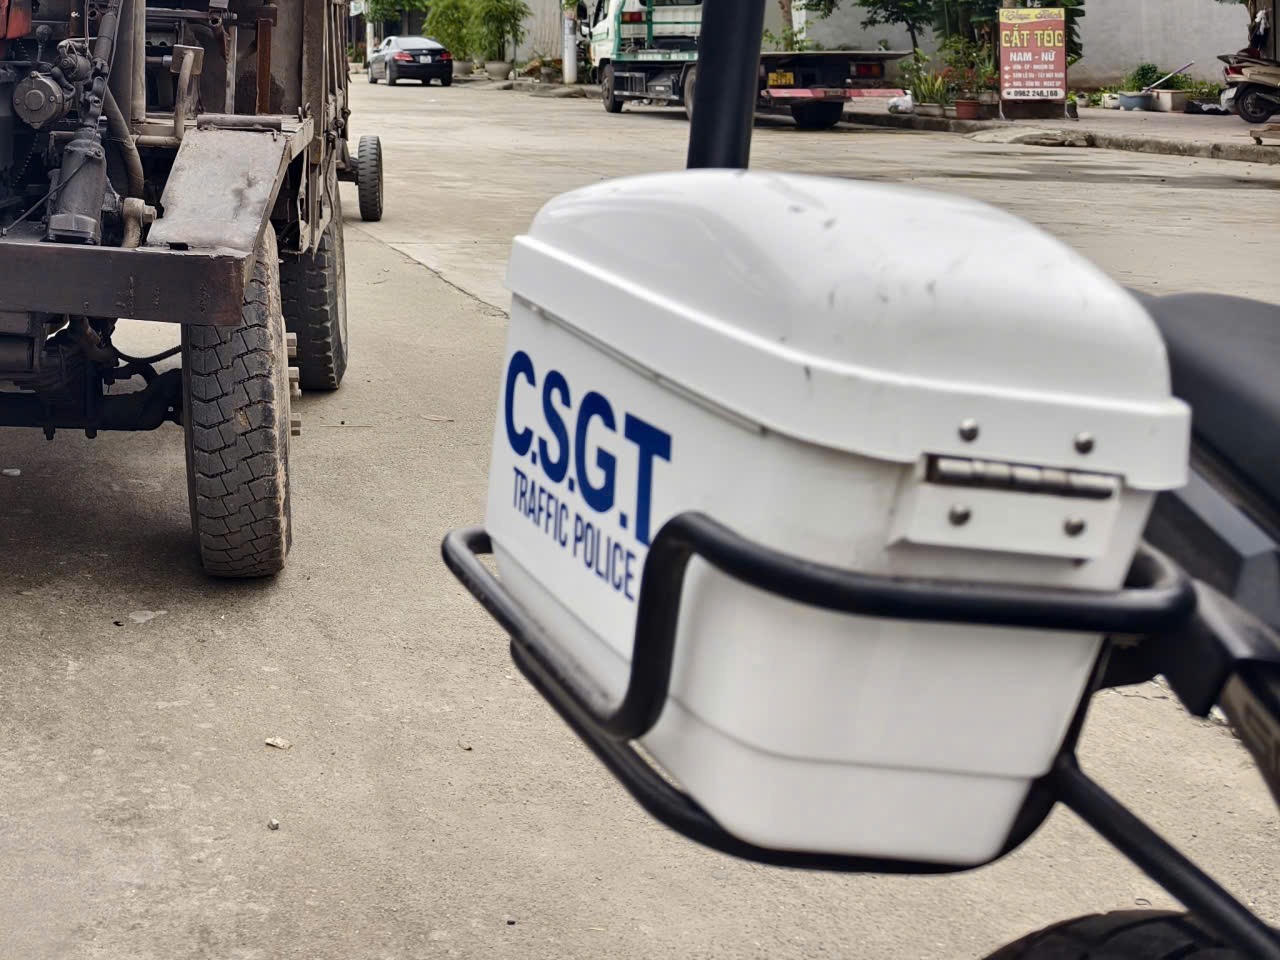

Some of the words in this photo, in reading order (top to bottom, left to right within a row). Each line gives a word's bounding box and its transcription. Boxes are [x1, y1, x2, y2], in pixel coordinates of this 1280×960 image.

[1002, 24, 1030, 47] CẮT
[1010, 51, 1032, 62] NAM
[513, 467, 569, 548] TRAFFIC
[573, 513, 637, 602] POLICE
